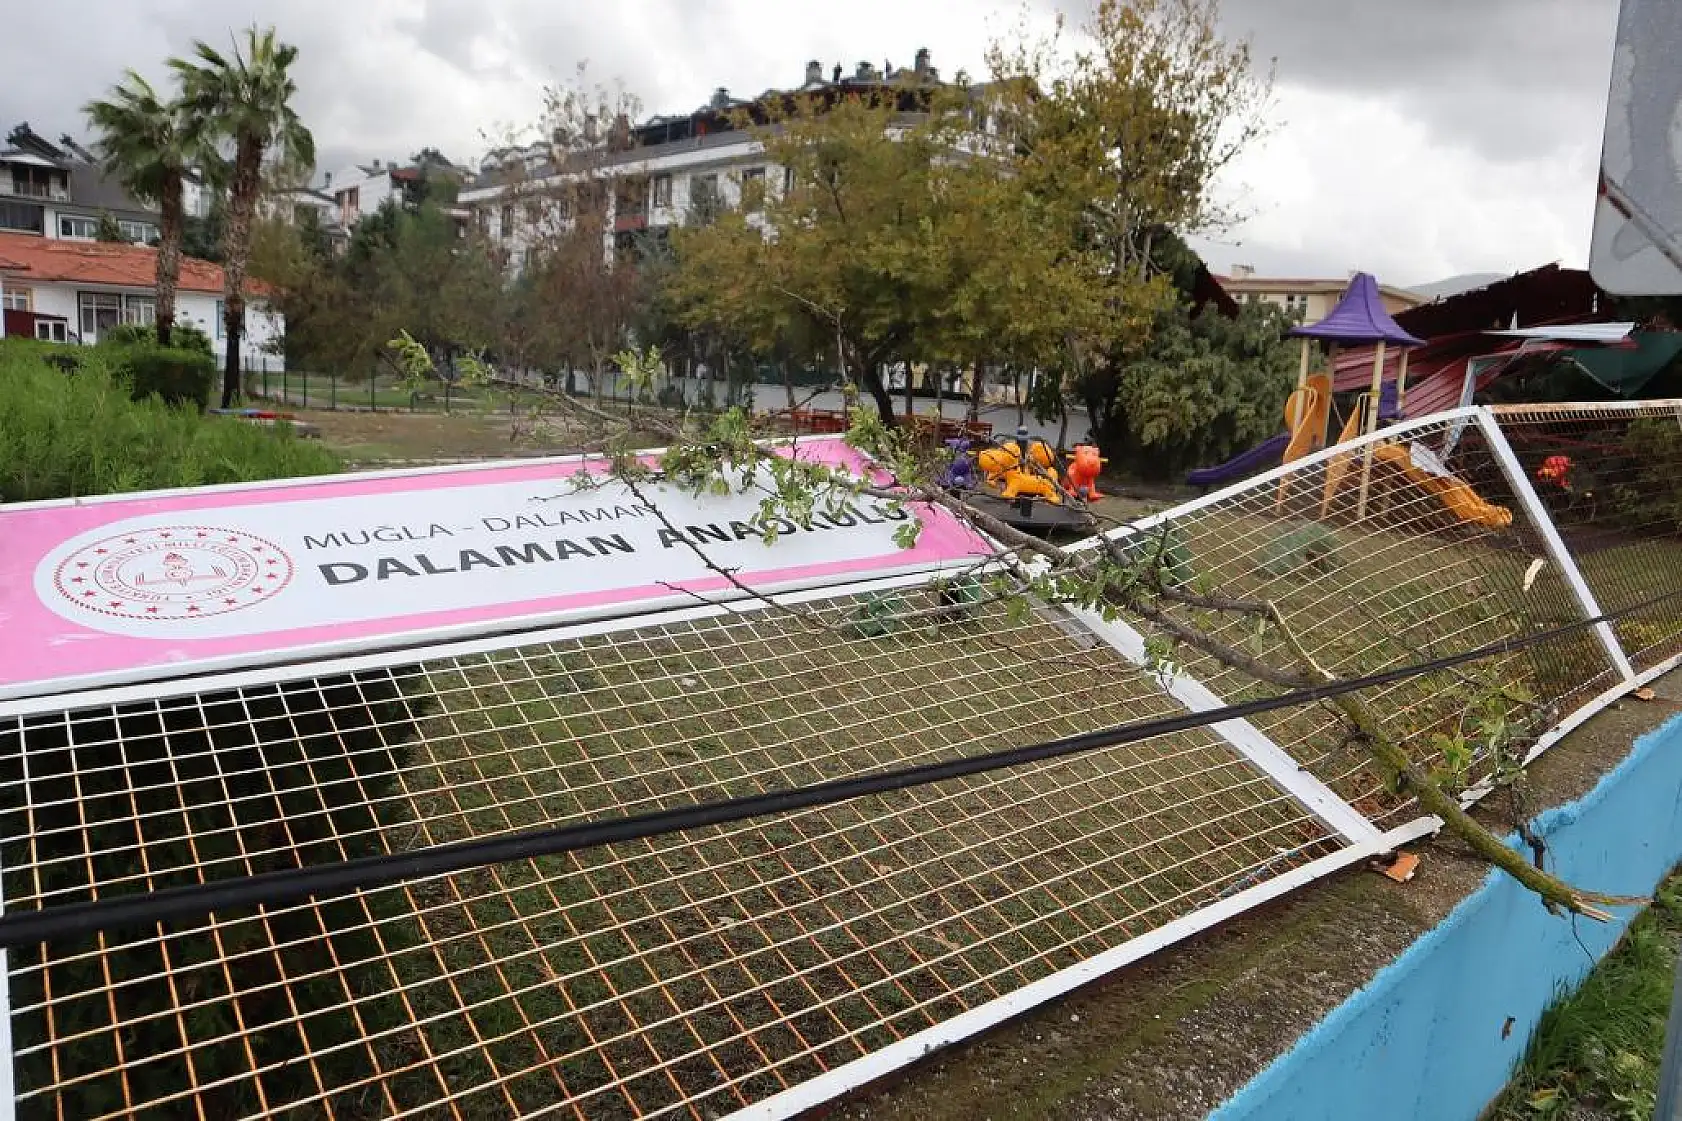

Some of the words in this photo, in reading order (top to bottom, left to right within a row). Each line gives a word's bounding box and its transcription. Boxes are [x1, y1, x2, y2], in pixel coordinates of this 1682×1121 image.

[303, 523, 455, 550] MUĞLA
[482, 504, 659, 532] DALAMAN
[317, 533, 636, 586] DALAMAN
